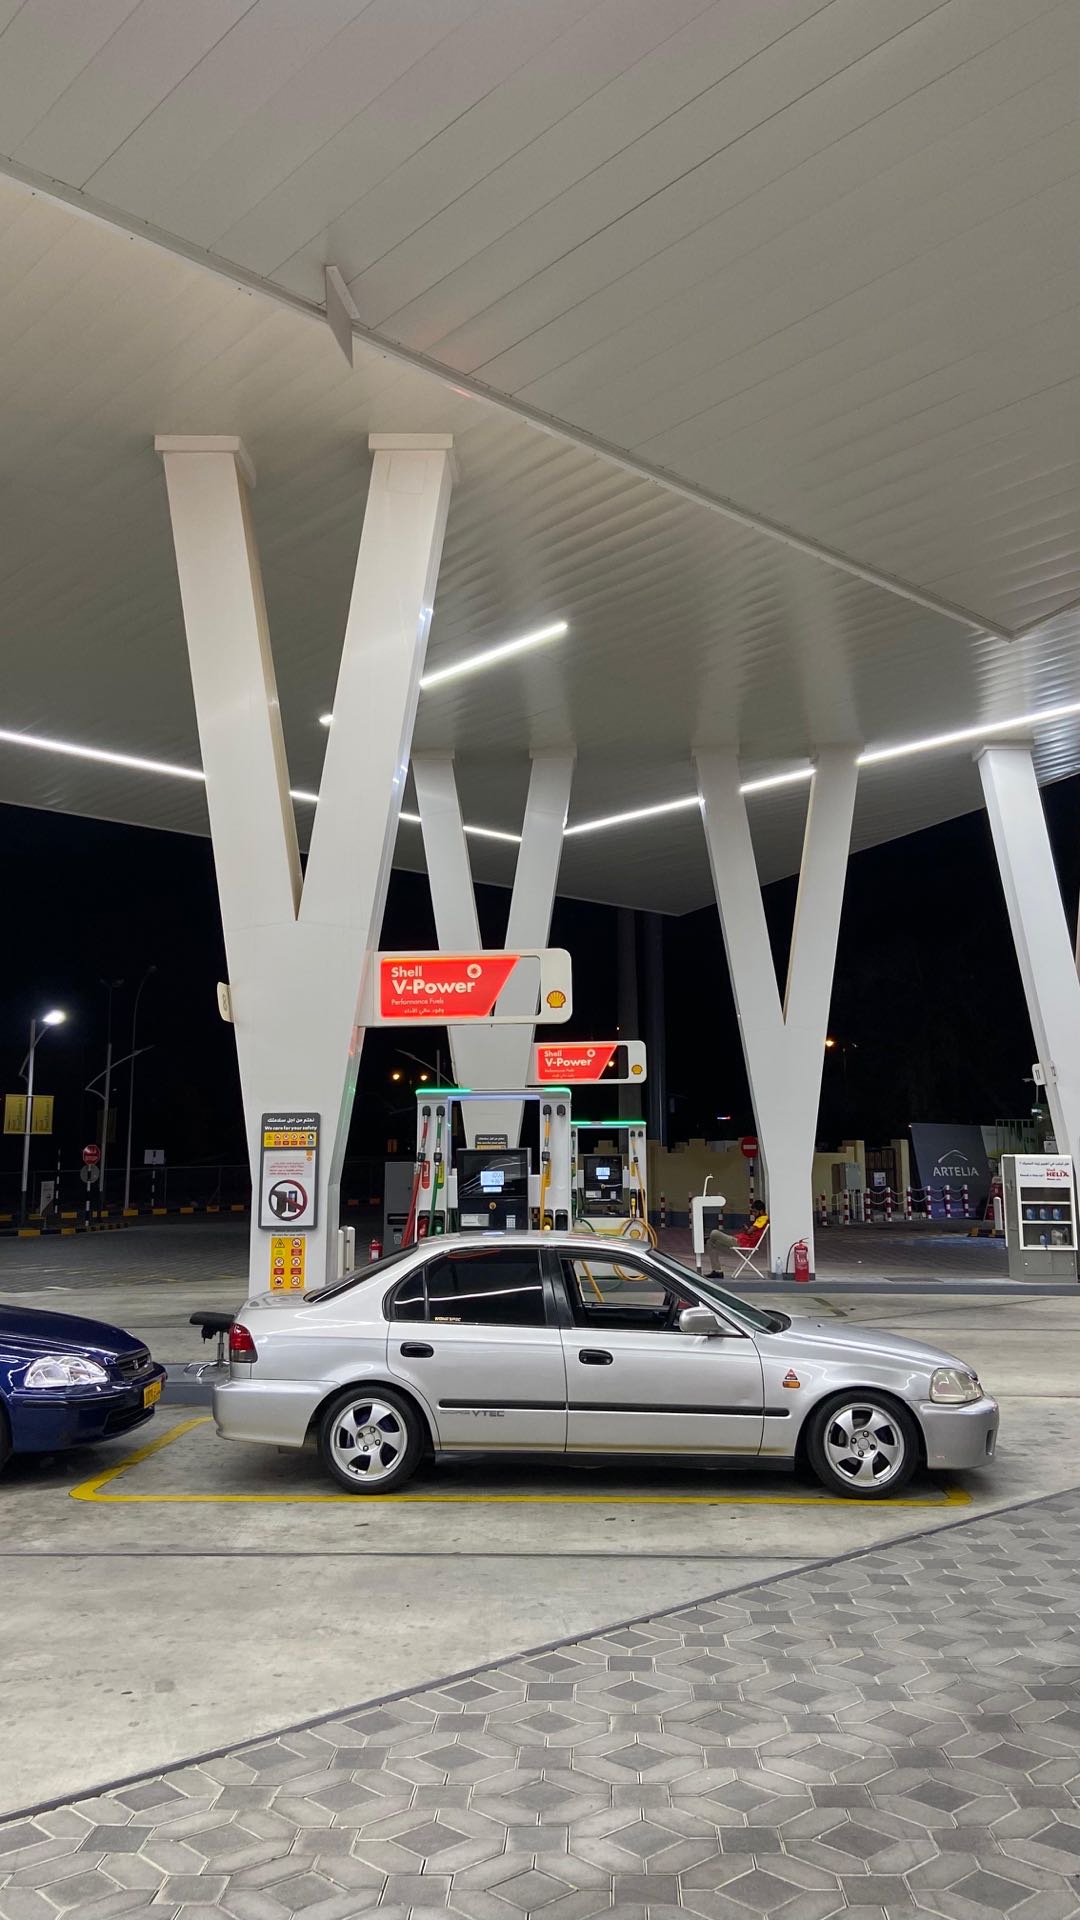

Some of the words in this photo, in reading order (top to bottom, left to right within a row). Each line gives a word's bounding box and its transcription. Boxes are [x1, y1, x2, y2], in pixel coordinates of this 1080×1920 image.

[391, 965, 423, 978] Shell
[391, 979, 476, 995] V-Power
[391, 998, 429, 1006] Performance
[544, 1050, 562, 1058] Shell
[545, 1058, 592, 1067] V-Power
[933, 1166, 979, 1177] ARTELIA
